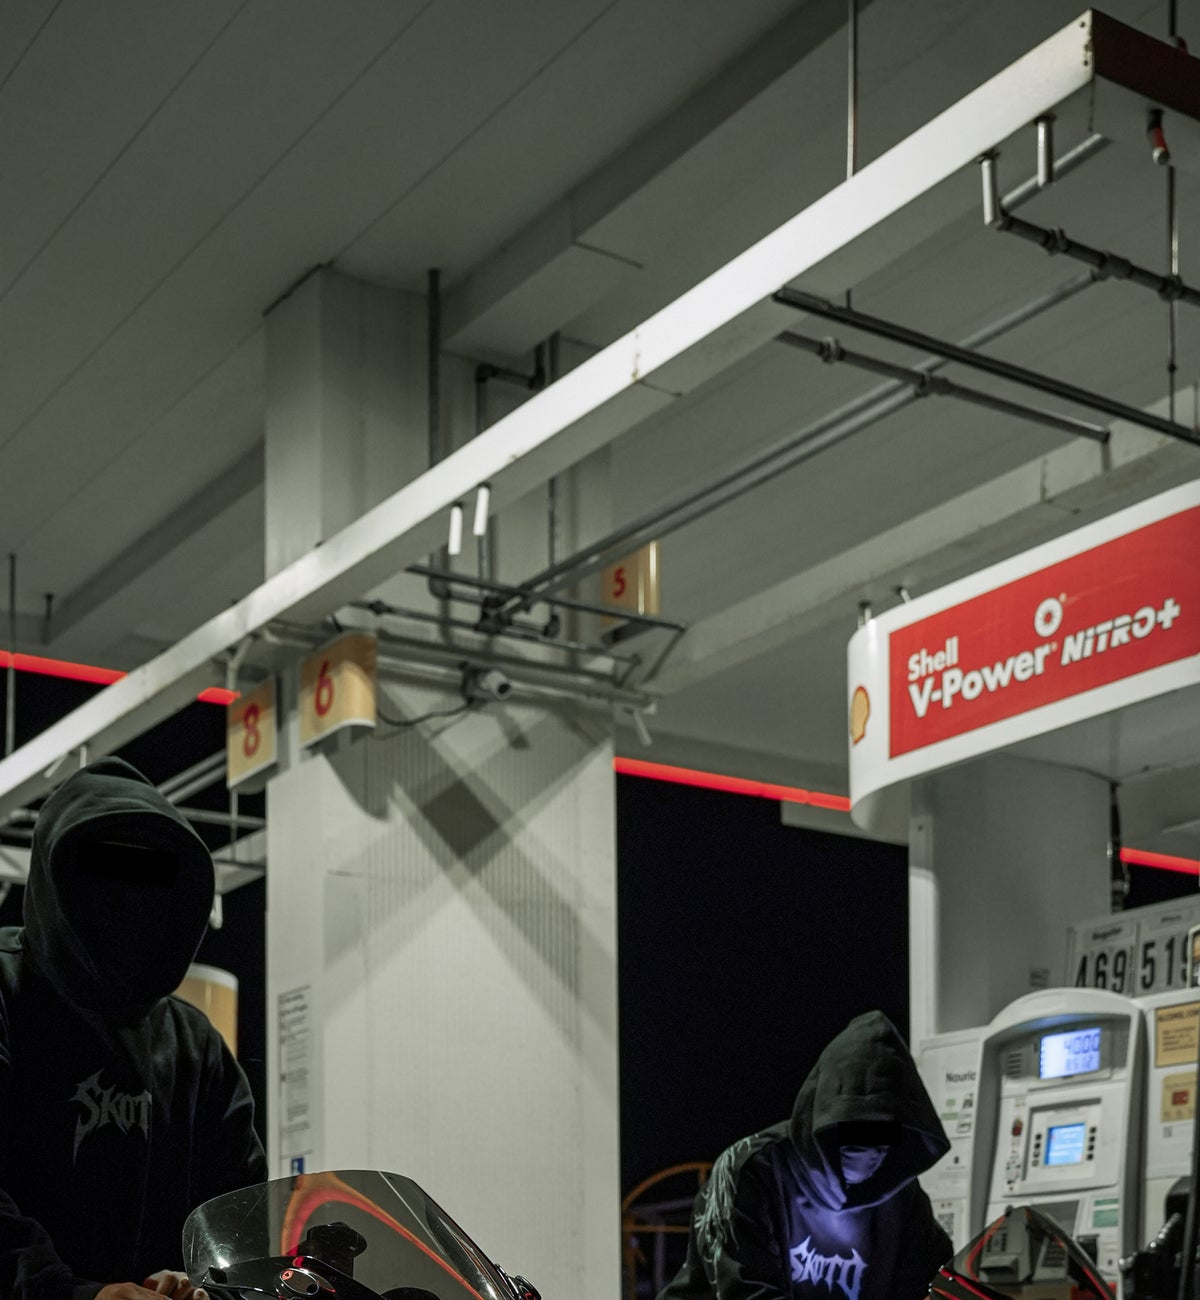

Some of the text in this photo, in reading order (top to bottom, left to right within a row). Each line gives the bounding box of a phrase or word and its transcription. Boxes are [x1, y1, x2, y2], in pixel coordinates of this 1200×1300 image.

[612, 567, 627, 598] 5
[908, 636, 958, 682] Shell
[908, 643, 1051, 718] V-Power
[314, 659, 335, 717] 6
[242, 702, 262, 758] 8
